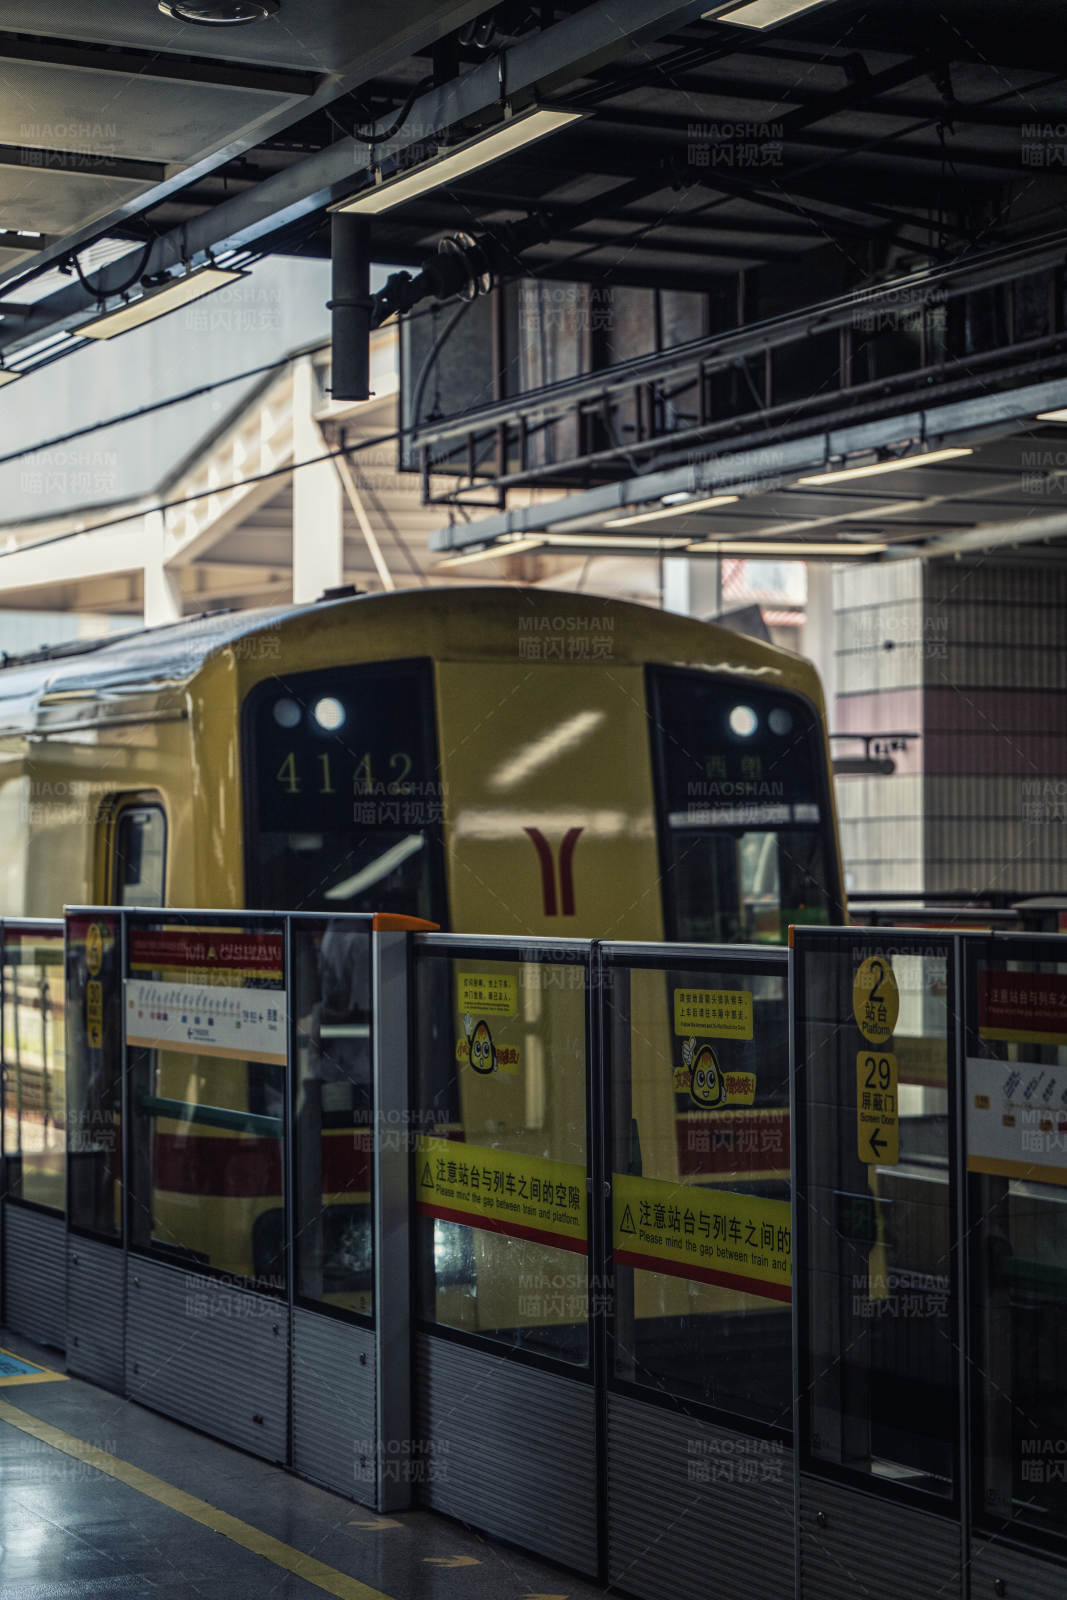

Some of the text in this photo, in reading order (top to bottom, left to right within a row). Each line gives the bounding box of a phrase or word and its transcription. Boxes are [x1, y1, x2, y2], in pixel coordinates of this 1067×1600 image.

[869, 961, 884, 1002] 2
[862, 1022, 890, 1036] Platform
[865, 1003, 887, 1024] 站台
[865, 1057, 890, 1089] 29
[862, 1092, 895, 1113] 屏蔽门
[436, 1159, 580, 1210] 注意站台与列车之间的空隙
[436, 1184, 455, 1198] Please
[456, 1190, 470, 1201] mind
[472, 1192, 481, 1203] the
[483, 1196, 495, 1208] gap
[496, 1196, 520, 1213] between
[523, 1204, 537, 1216] train
[538, 1207, 551, 1219] and
[639, 1200, 791, 1255] 注意站台与列车之间的
[639, 1230, 663, 1246] Please
[665, 1236, 682, 1249] mind
[685, 1240, 697, 1252] the
[700, 1245, 714, 1257] gap
[717, 1245, 748, 1263] between
[751, 1254, 769, 1267] train
[772, 1258, 787, 1271] and
